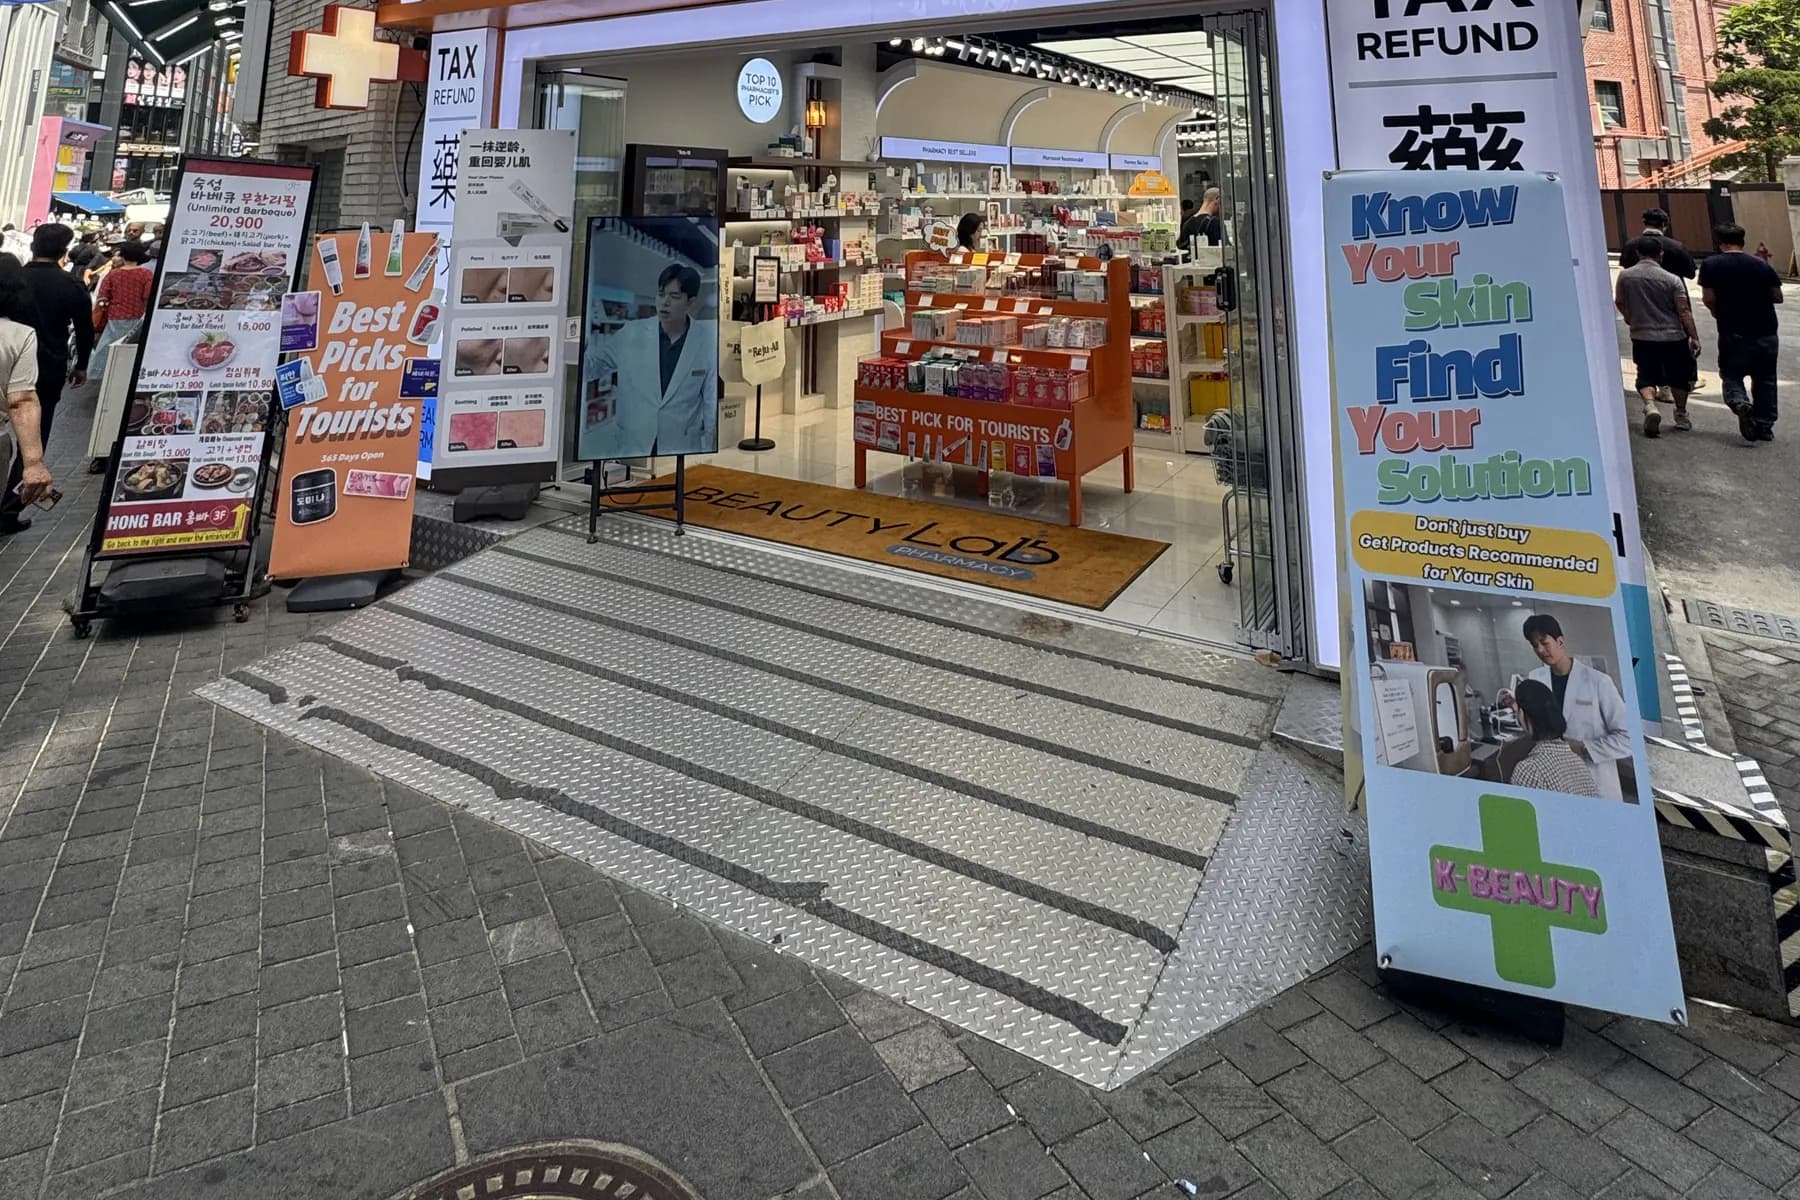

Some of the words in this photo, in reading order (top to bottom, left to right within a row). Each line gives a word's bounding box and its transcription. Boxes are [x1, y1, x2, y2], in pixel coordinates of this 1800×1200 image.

[1356, 21, 1540, 61] REFUND
[438, 44, 478, 81] TAX
[433, 87, 476, 106] REFUND
[745, 72, 766, 86] TOP
[767, 76, 777, 88] 10
[749, 95, 772, 107] PICK
[468, 156, 531, 168] 重回婴儿肌
[190, 191, 236, 204] 바베큐
[241, 192, 296, 208] 무한리필
[193, 177, 222, 191] 숙성
[187, 202, 240, 214] (Unlimited
[243, 206, 297, 217] Barbeque)
[1351, 184, 1519, 240] Know
[1341, 240, 1461, 285] Your
[328, 301, 407, 334] Best
[1402, 273, 1533, 331] Skin
[160, 367, 200, 377] 샤브샤브
[318, 338, 407, 373] Picks
[1375, 332, 1524, 405] Find
[339, 377, 379, 402] for
[295, 401, 416, 441] Tourists
[875, 405, 908, 424] BEST
[911, 409, 942, 428] PICK
[947, 415, 974, 433] FOR
[978, 419, 1050, 443] TOURISTS
[1346, 404, 1481, 456] Your
[321, 452, 337, 463] 365
[338, 453, 359, 463] Days
[361, 451, 384, 461] Open
[1377, 450, 1592, 505] Solution
[107, 514, 148, 531] HONG
[152, 512, 182, 527] BAR
[185, 510, 209, 526] 홍빠
[214, 510, 226, 520] 3F
[683, 485, 911, 535] BEAUTY
[900, 521, 1061, 566] Lab
[1415, 515, 1460, 536] Don't
[1461, 520, 1496, 540] just
[1497, 524, 1530, 544] buy
[891, 545, 1031, 579] PHARMACY
[1359, 534, 1390, 552] Get
[1391, 537, 1466, 562] Products
[1468, 545, 1599, 575] Recommended
[1422, 564, 1450, 582] for
[1451, 567, 1493, 588] Your
[1495, 572, 1534, 592] Skin
[1433, 857, 1600, 920] K-BEAUTY
